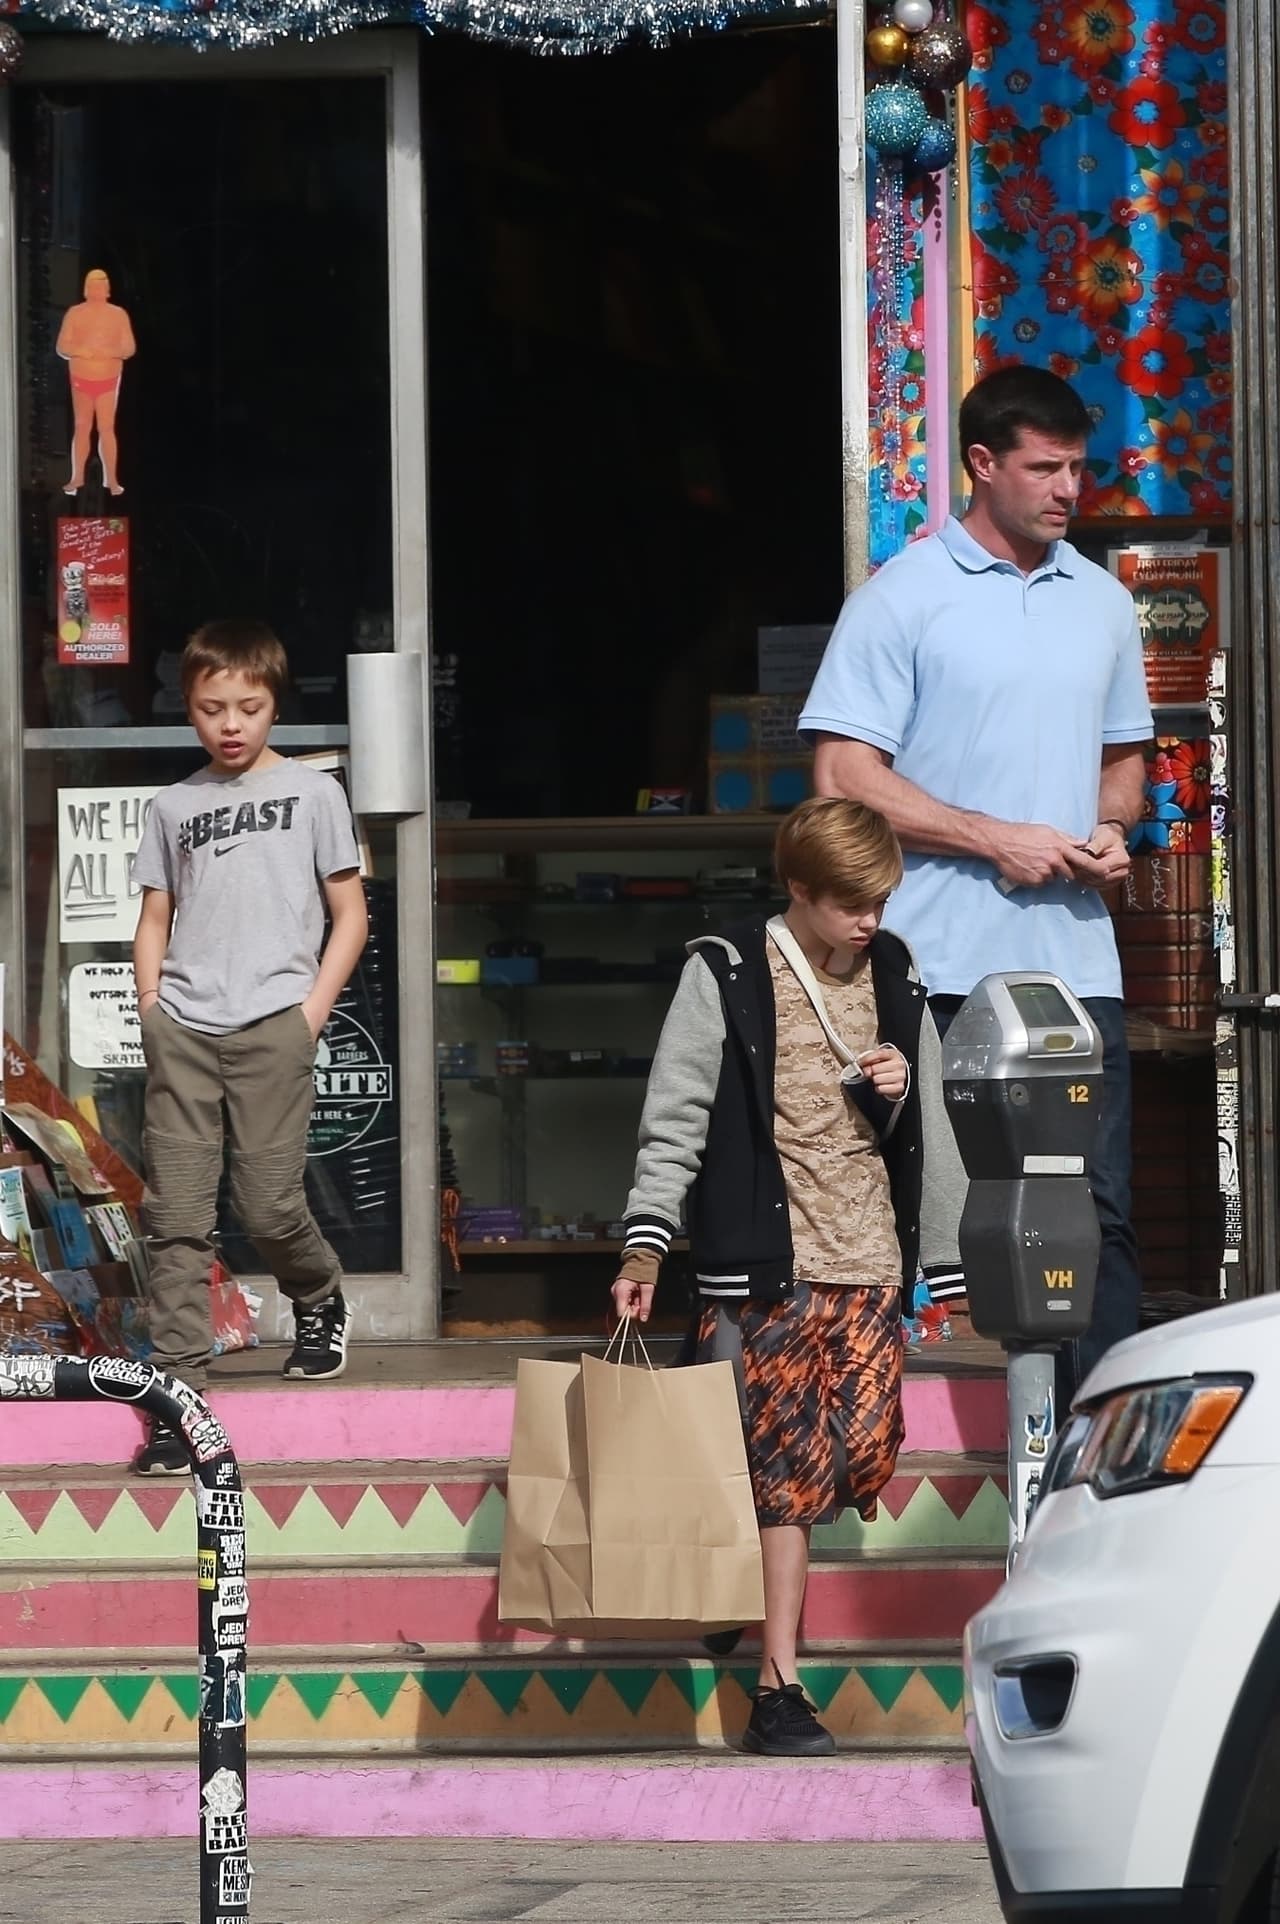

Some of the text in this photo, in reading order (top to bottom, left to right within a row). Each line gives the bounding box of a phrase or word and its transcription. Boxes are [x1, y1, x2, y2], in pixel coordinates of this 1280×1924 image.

[90, 623, 120, 631] SOLD
[64, 643, 125, 652] AUTHORIZED
[76, 652, 113, 660] DEALER
[67, 801, 113, 842] WE
[64, 853, 116, 900] ALL
[1067, 1085, 1089, 1102] 12
[1043, 1270, 1073, 1288] VH
